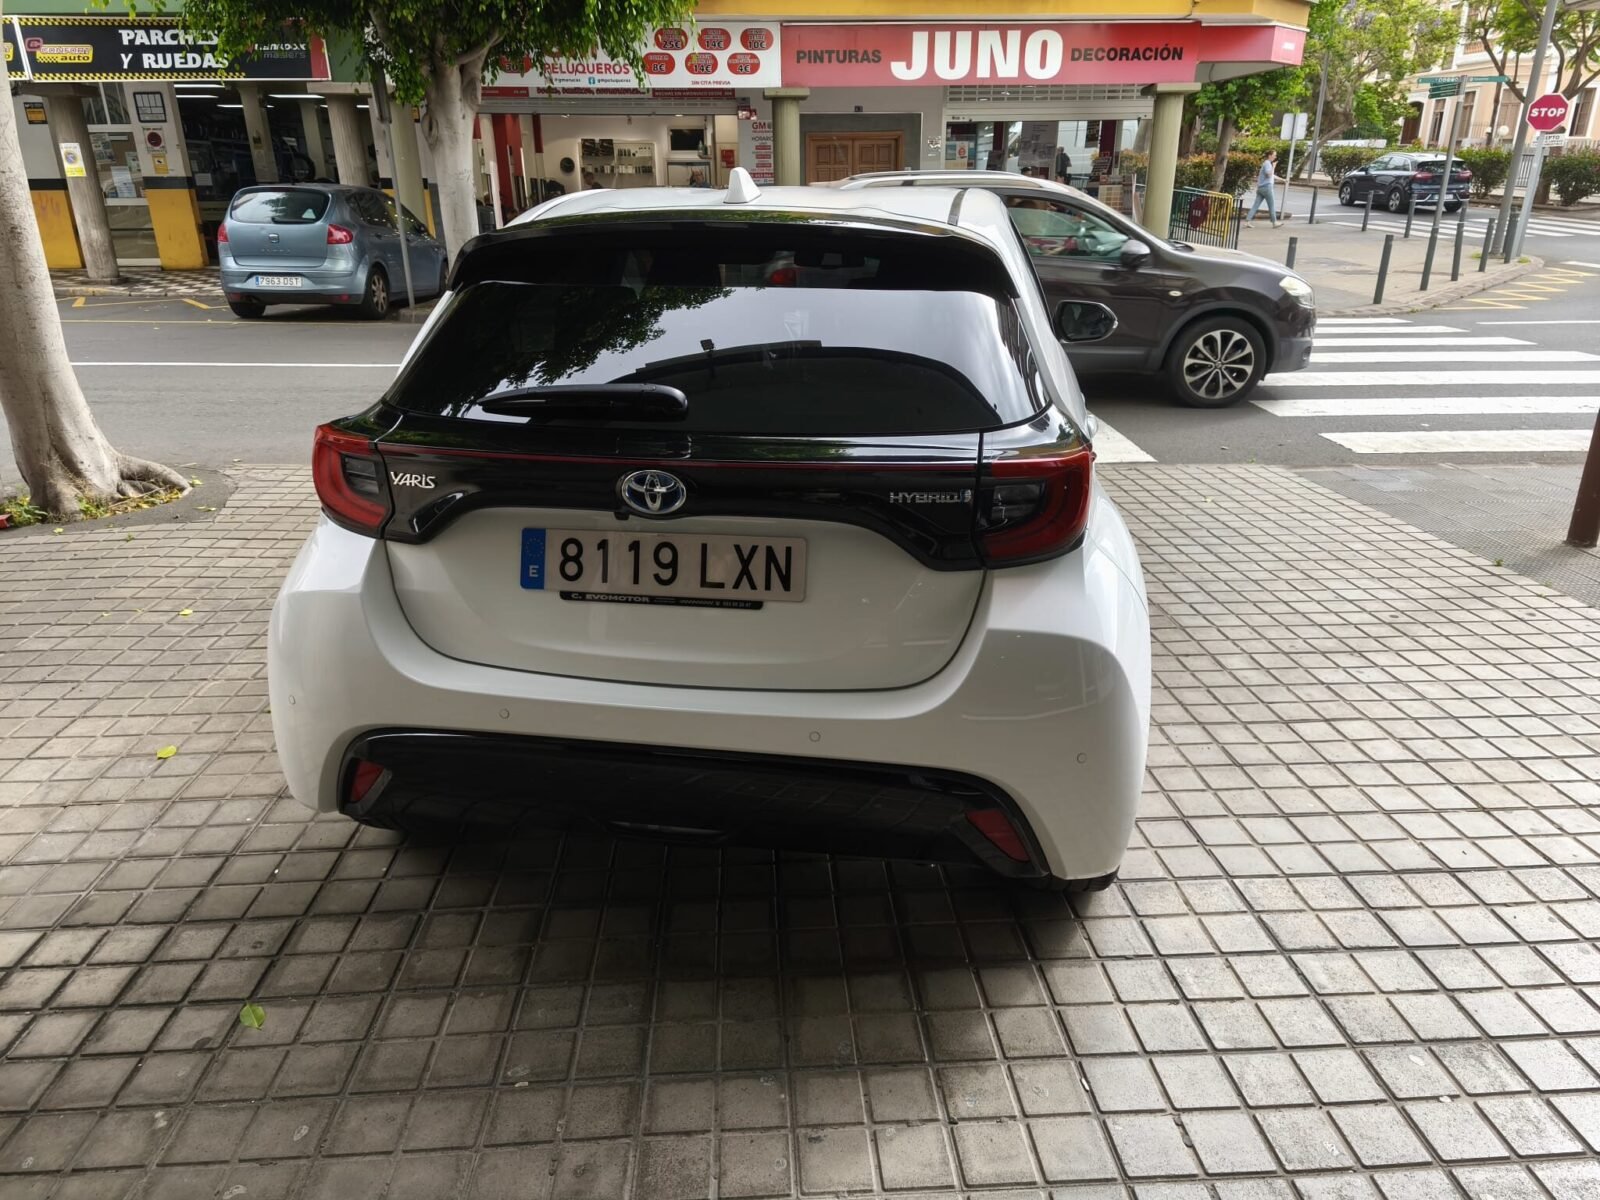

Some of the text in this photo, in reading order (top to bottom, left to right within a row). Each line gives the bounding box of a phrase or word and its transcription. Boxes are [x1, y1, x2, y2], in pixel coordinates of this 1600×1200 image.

[662, 40, 681, 49] 25€
[705, 40, 724, 49] 14€
[748, 40, 766, 49] 10€
[795, 29, 1184, 80] PINTURAS JUNO DECORACIÓN
[120, 53, 229, 69] Y RUEDAS
[544, 63, 630, 75] PELUQUEROS
[652, 63, 666, 72] 8€
[693, 64, 712, 73] 14€
[737, 64, 751, 73] 4€
[1530, 107, 1566, 117] STOP
[752, 121, 766, 130] GM
[260, 277, 281, 285] 7963
[390, 471, 436, 489] YARIS
[889, 491, 960, 503] HYBRID
[559, 537, 792, 591] 8119 LXN
[529, 565, 539, 577] E
[585, 593, 650, 603] EVOMOTOR
